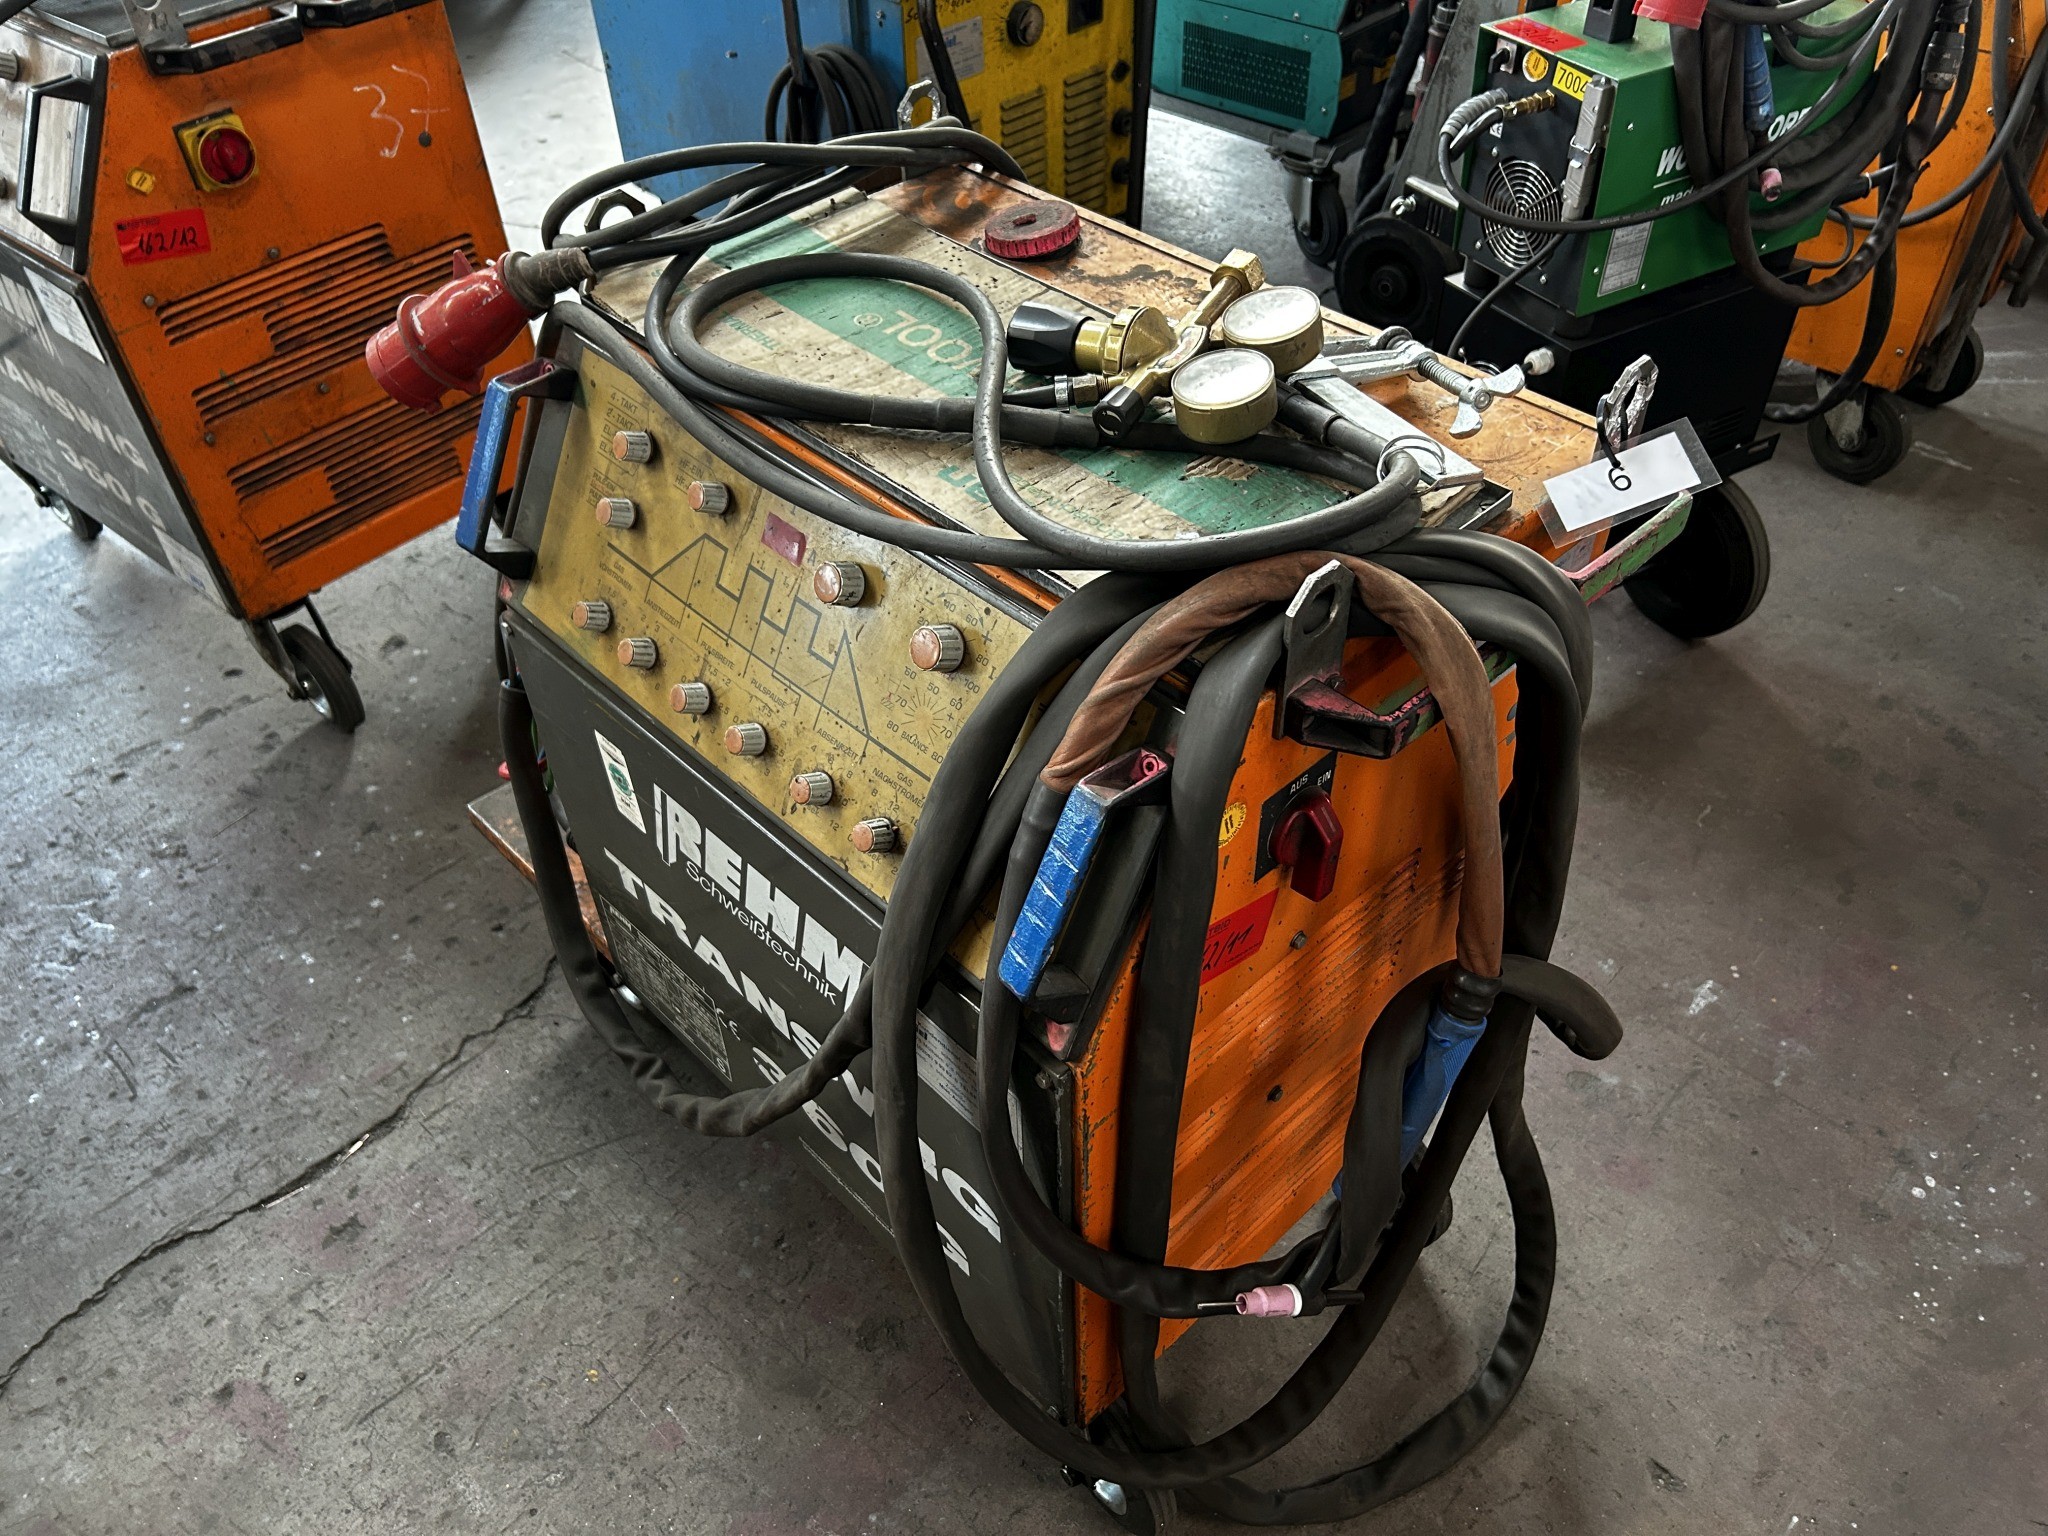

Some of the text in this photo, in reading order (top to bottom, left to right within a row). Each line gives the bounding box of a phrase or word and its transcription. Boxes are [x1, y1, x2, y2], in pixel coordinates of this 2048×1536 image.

[353, 64, 450, 158] 37
[1608, 466, 1632, 491] 6
[1290, 773, 1309, 796] AUS
[1317, 769, 1332, 787] EIN
[653, 782, 864, 1014] REHM
[685, 860, 837, 1006] Schweißtechnik
